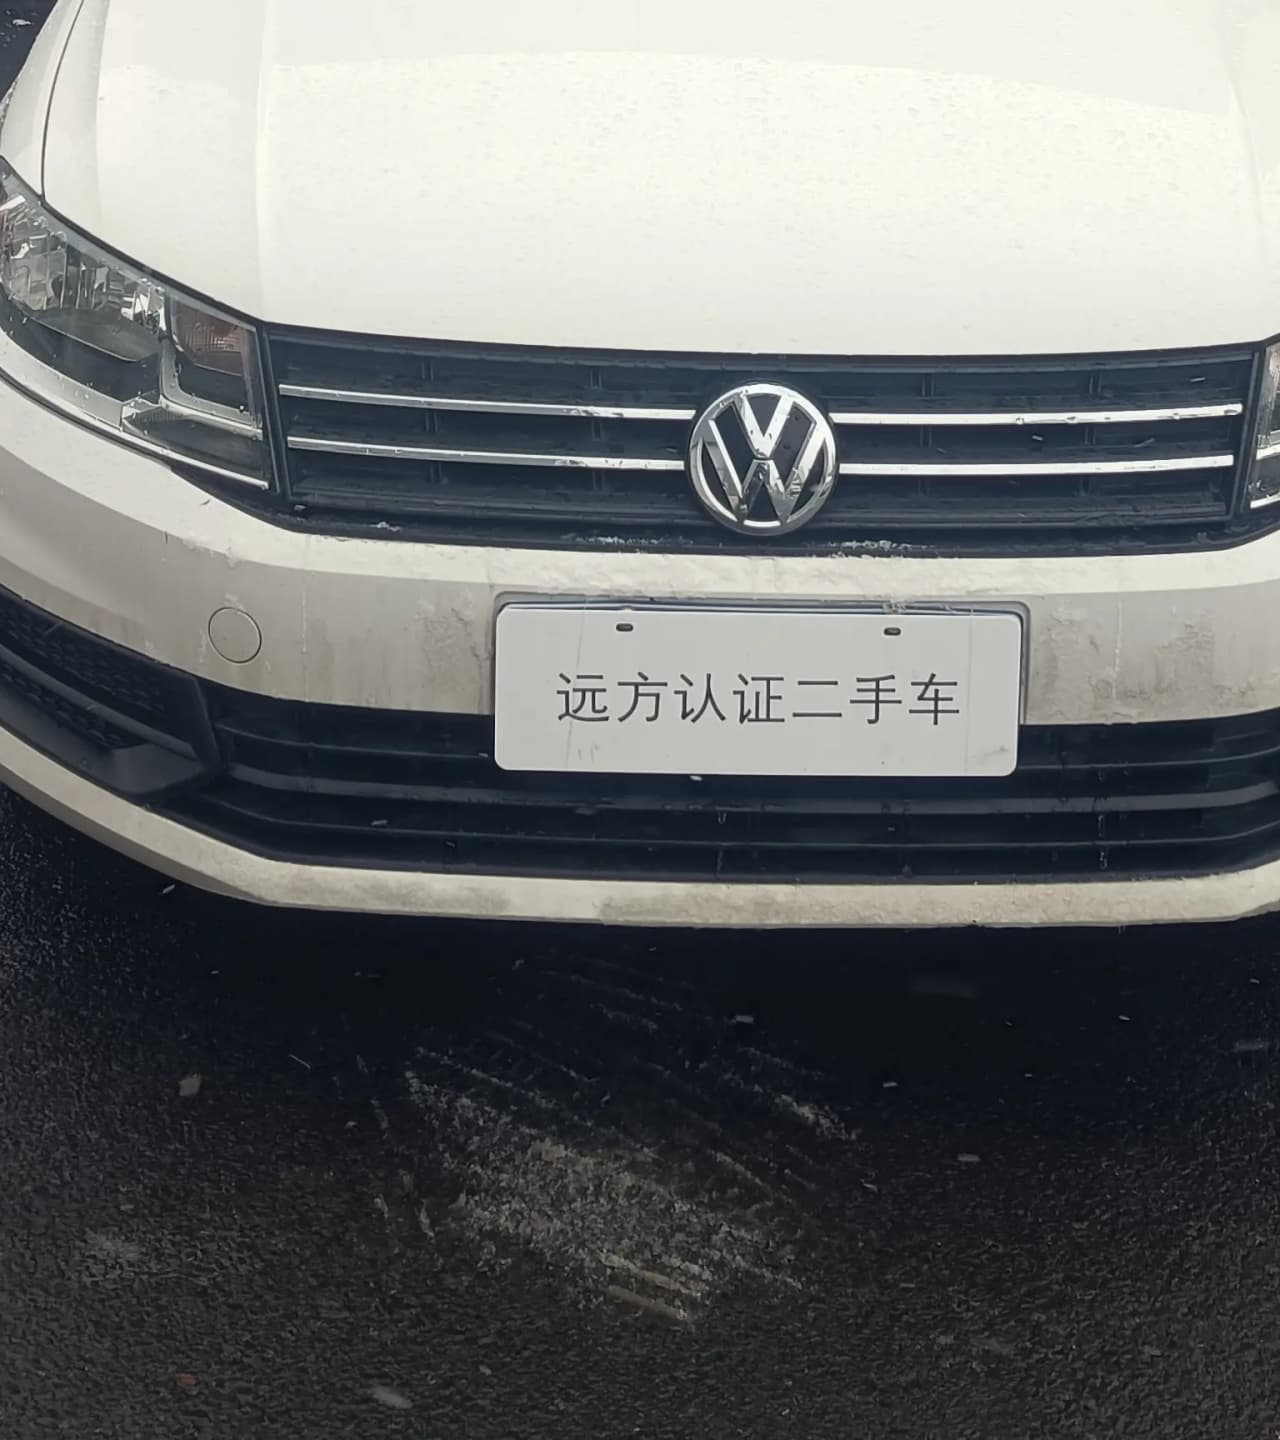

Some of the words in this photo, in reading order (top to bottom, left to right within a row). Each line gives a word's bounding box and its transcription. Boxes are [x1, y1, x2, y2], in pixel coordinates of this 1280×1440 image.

[556, 671, 960, 726] 远方认证二手车
